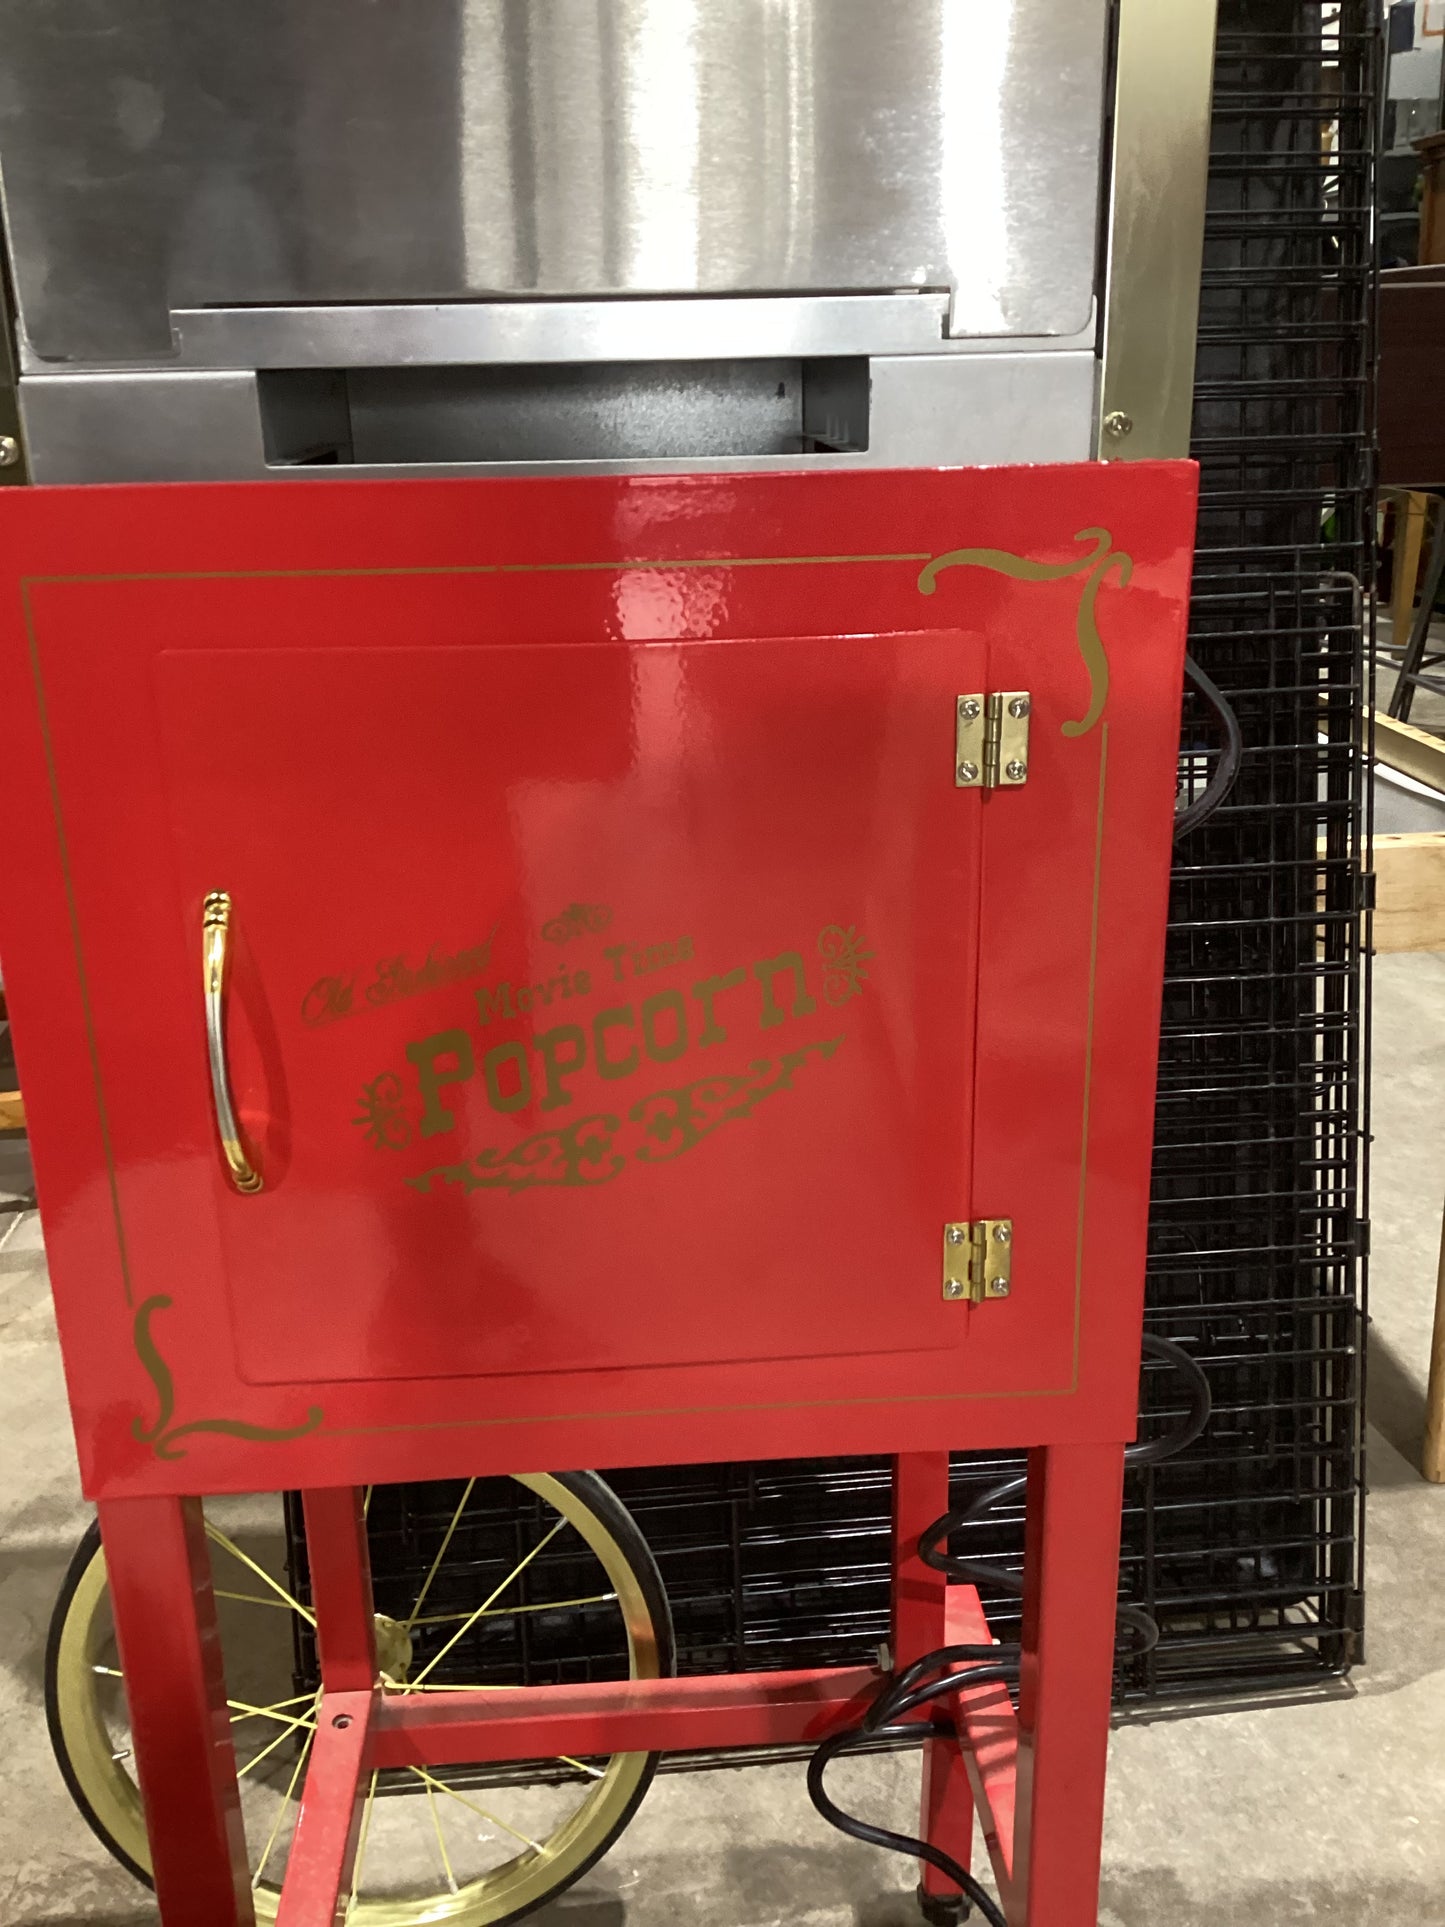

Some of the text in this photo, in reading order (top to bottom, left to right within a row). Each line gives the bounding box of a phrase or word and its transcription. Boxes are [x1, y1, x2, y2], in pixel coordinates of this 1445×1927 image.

[406, 950, 817, 1139] Popcorn
[474, 963, 592, 1026] Movie
[604, 934, 697, 983] Time
